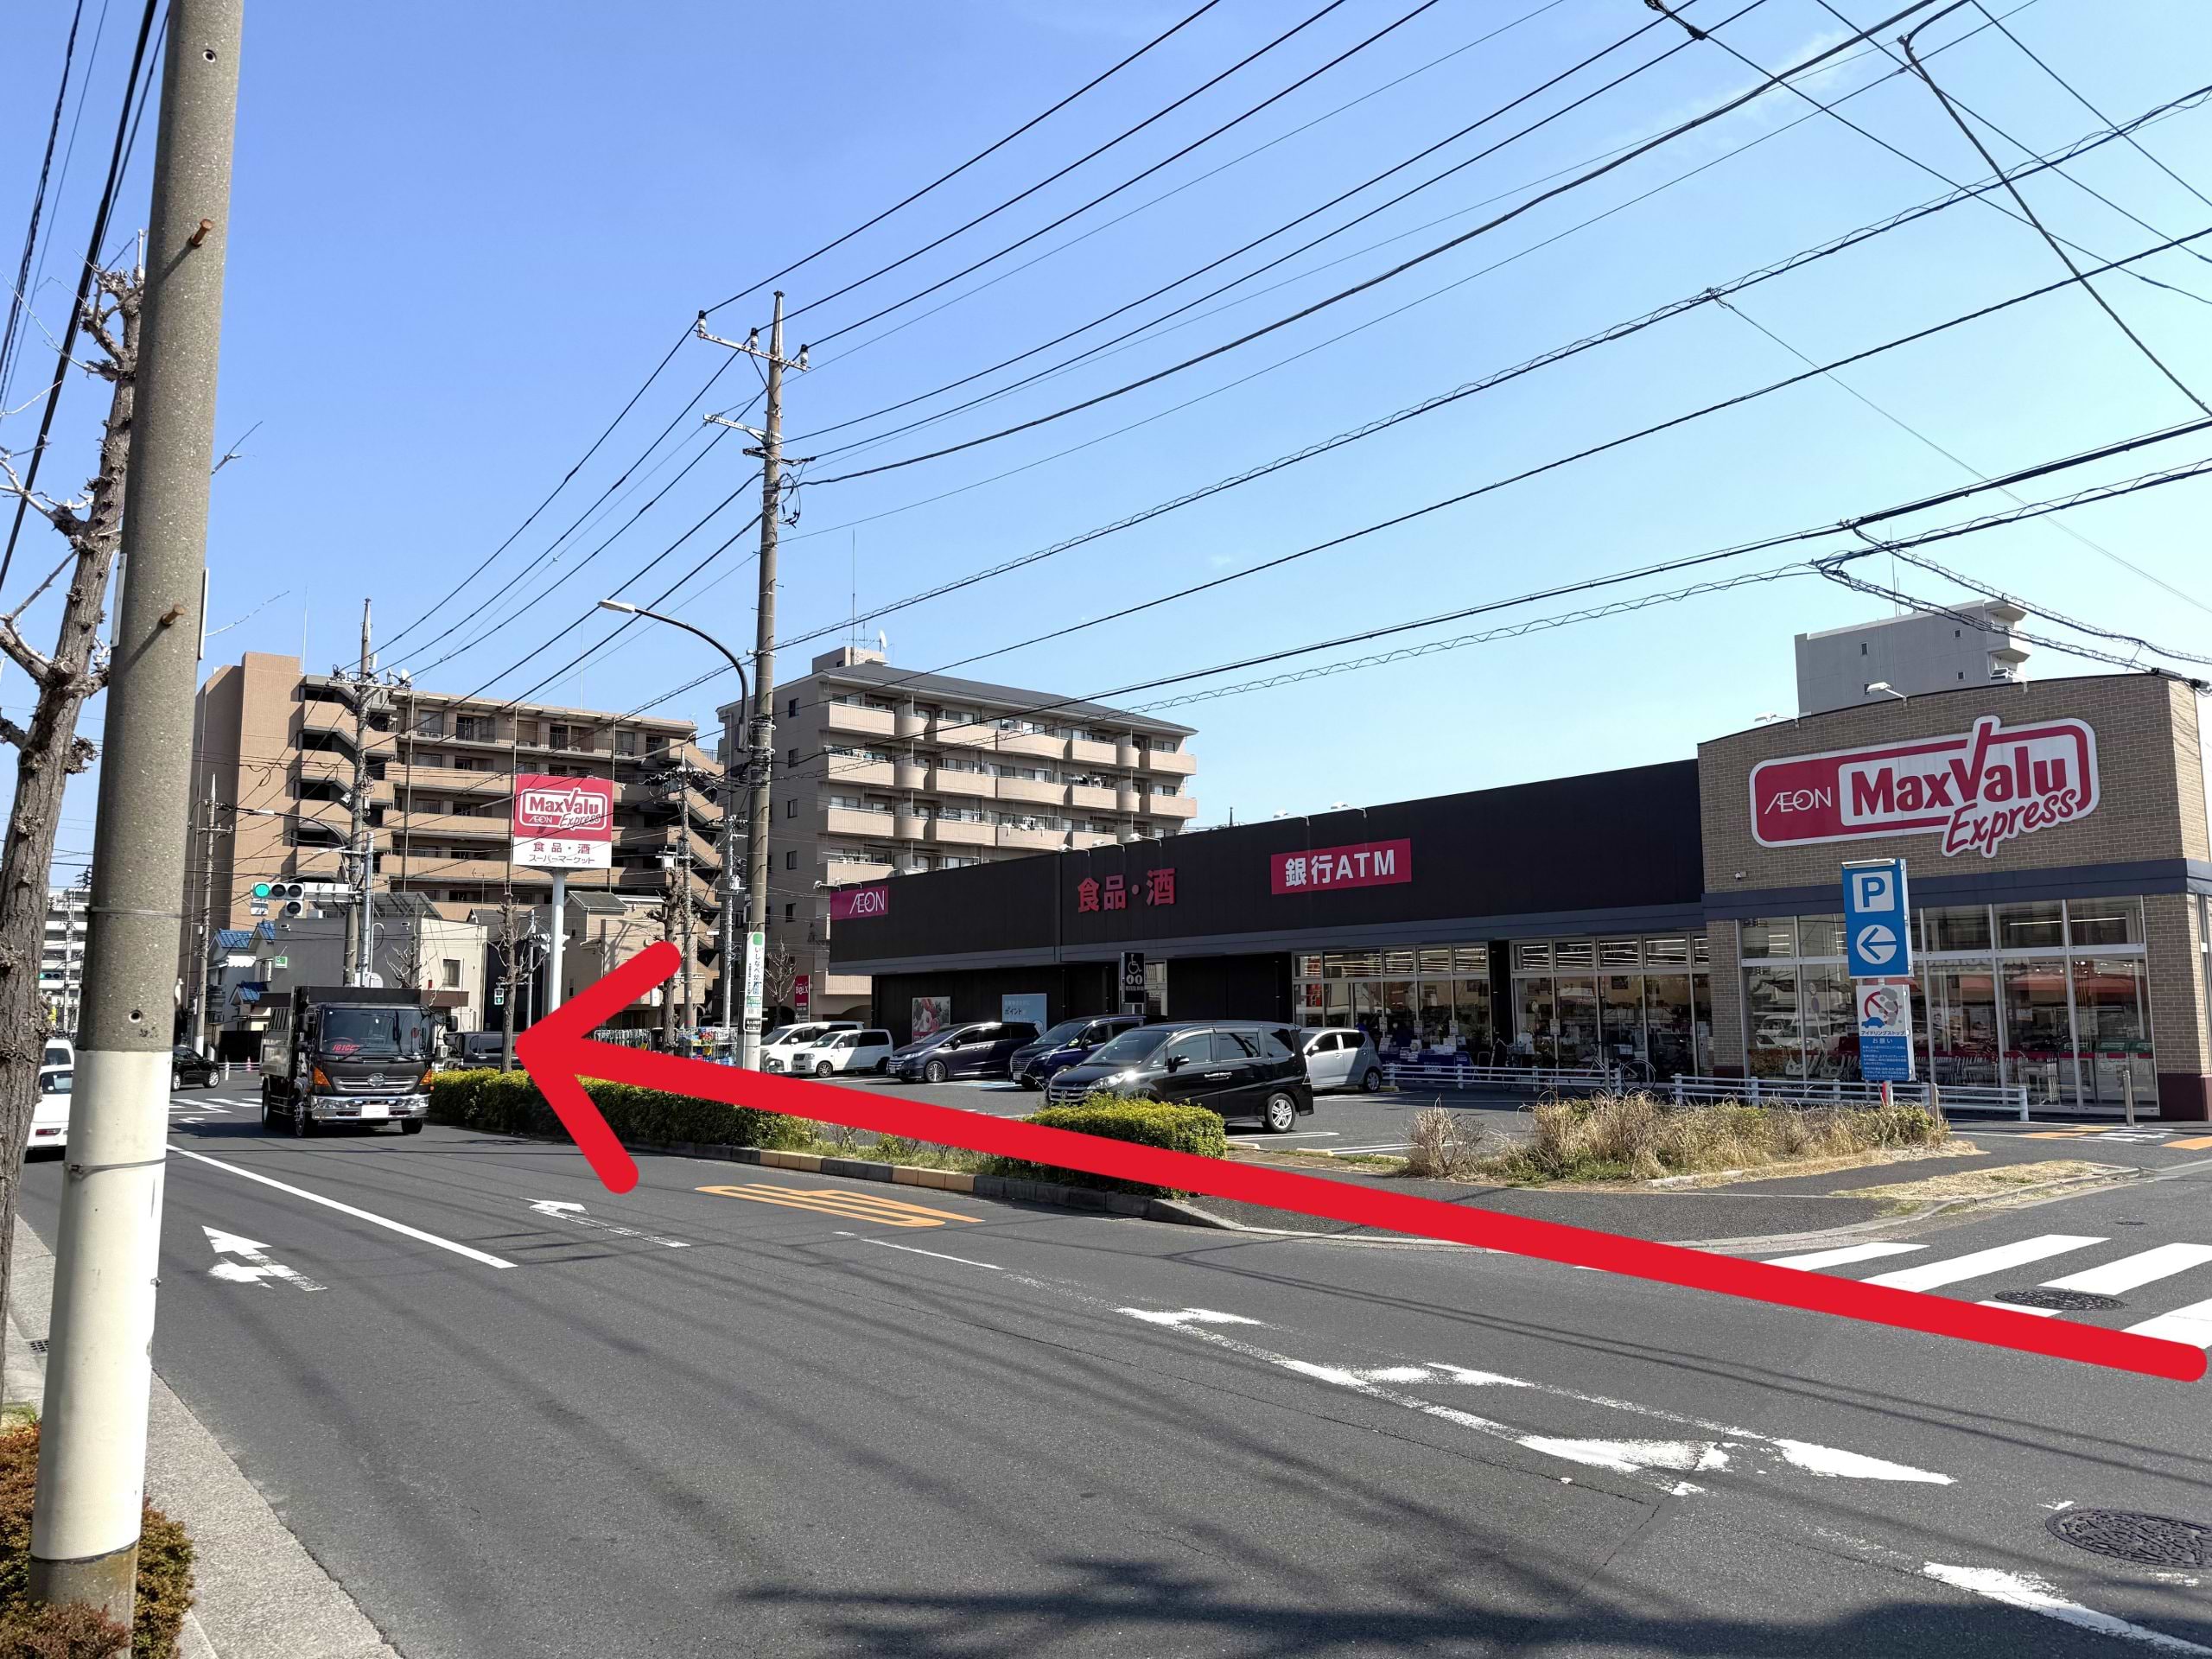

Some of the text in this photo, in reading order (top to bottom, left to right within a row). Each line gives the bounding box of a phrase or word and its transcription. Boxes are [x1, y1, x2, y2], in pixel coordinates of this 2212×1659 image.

[1851, 722, 2068, 817] MaxValu
[530, 790, 599, 815] MaxValu
[560, 813, 601, 829] Express
[1947, 789, 2076, 854] Express
[529, 855, 595, 864] スーパーマーケット
[533, 842, 591, 855] 食品・酒
[1285, 849, 1396, 887] 銀行ATM
[1077, 868, 1177, 913] 食品・酒
[1861, 876, 1885, 908] P
